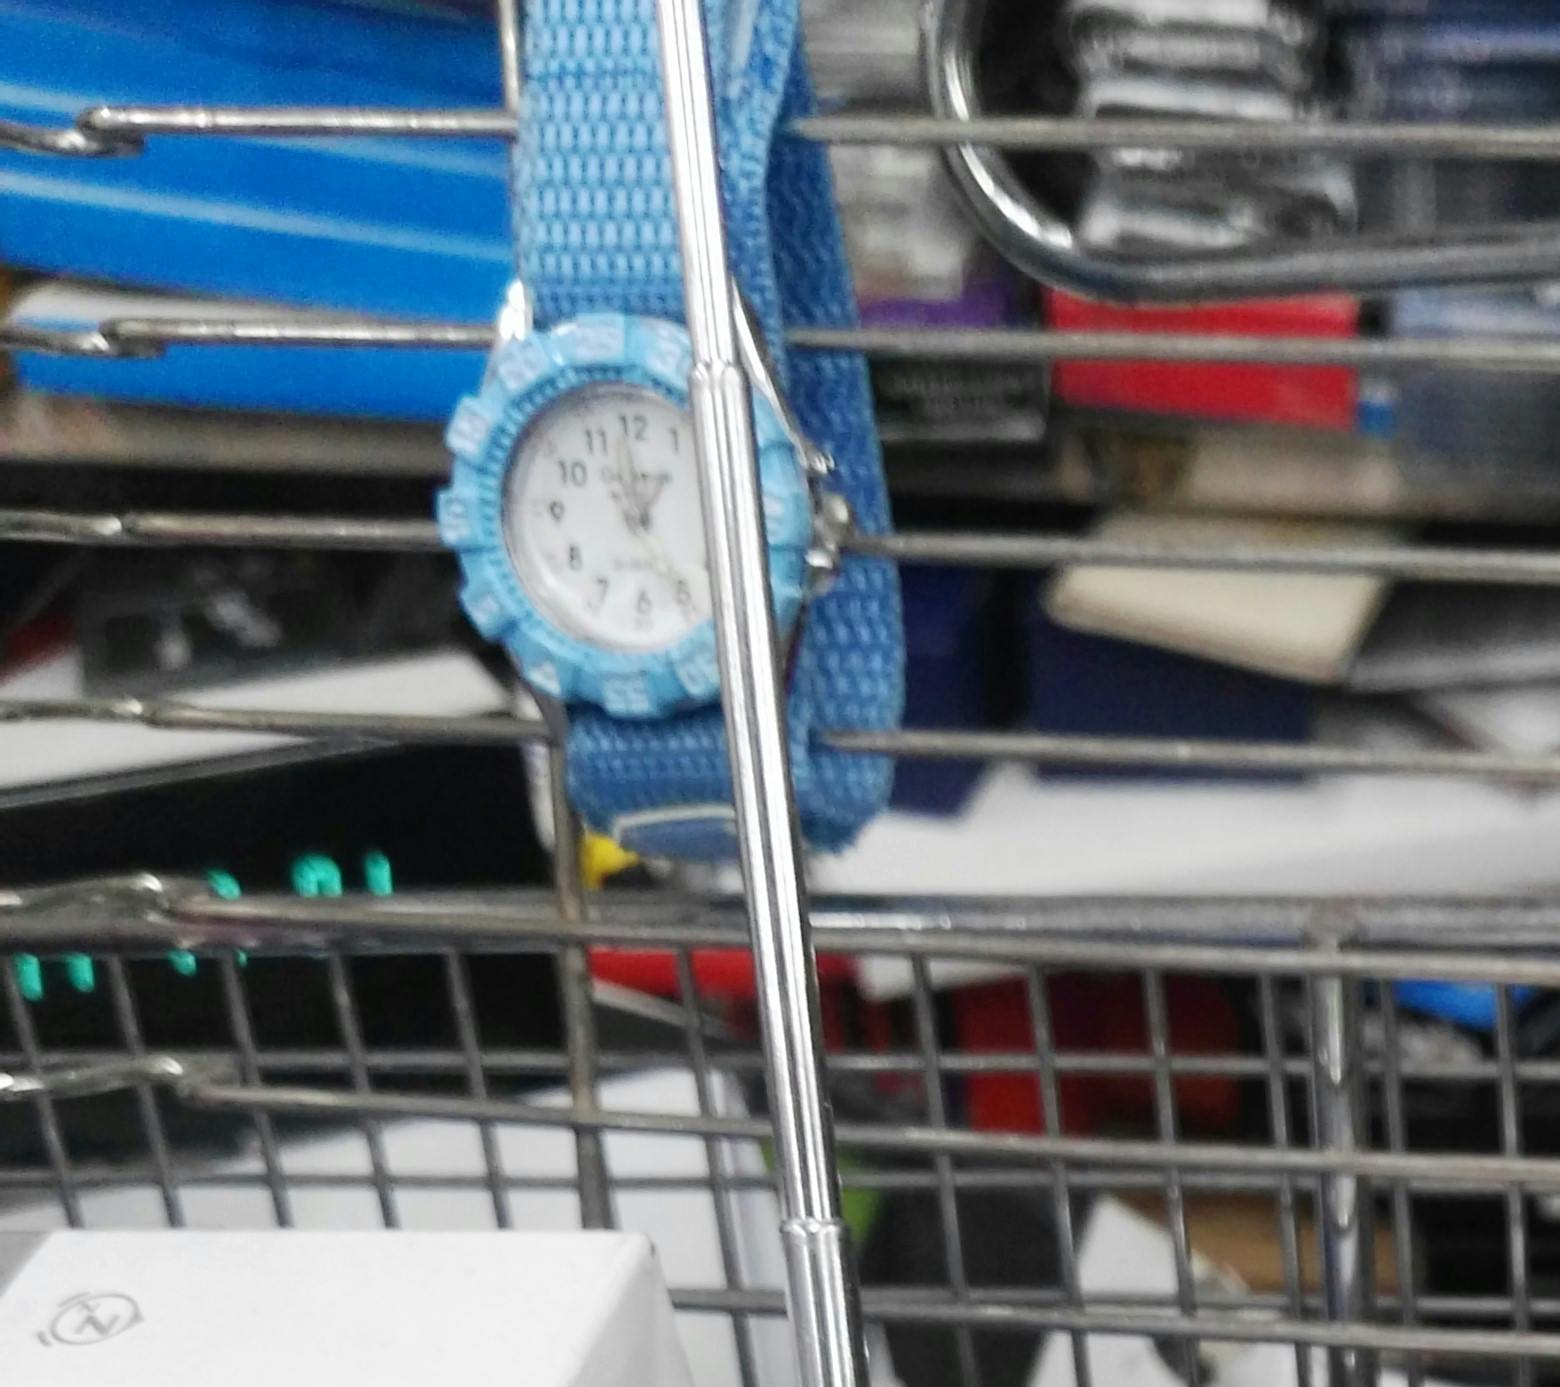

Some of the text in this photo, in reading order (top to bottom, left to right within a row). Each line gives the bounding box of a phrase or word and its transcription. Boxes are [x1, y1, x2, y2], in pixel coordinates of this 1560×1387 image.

[584, 428, 609, 454] 11
[618, 412, 648, 442] 12
[557, 459, 588, 488] 10
